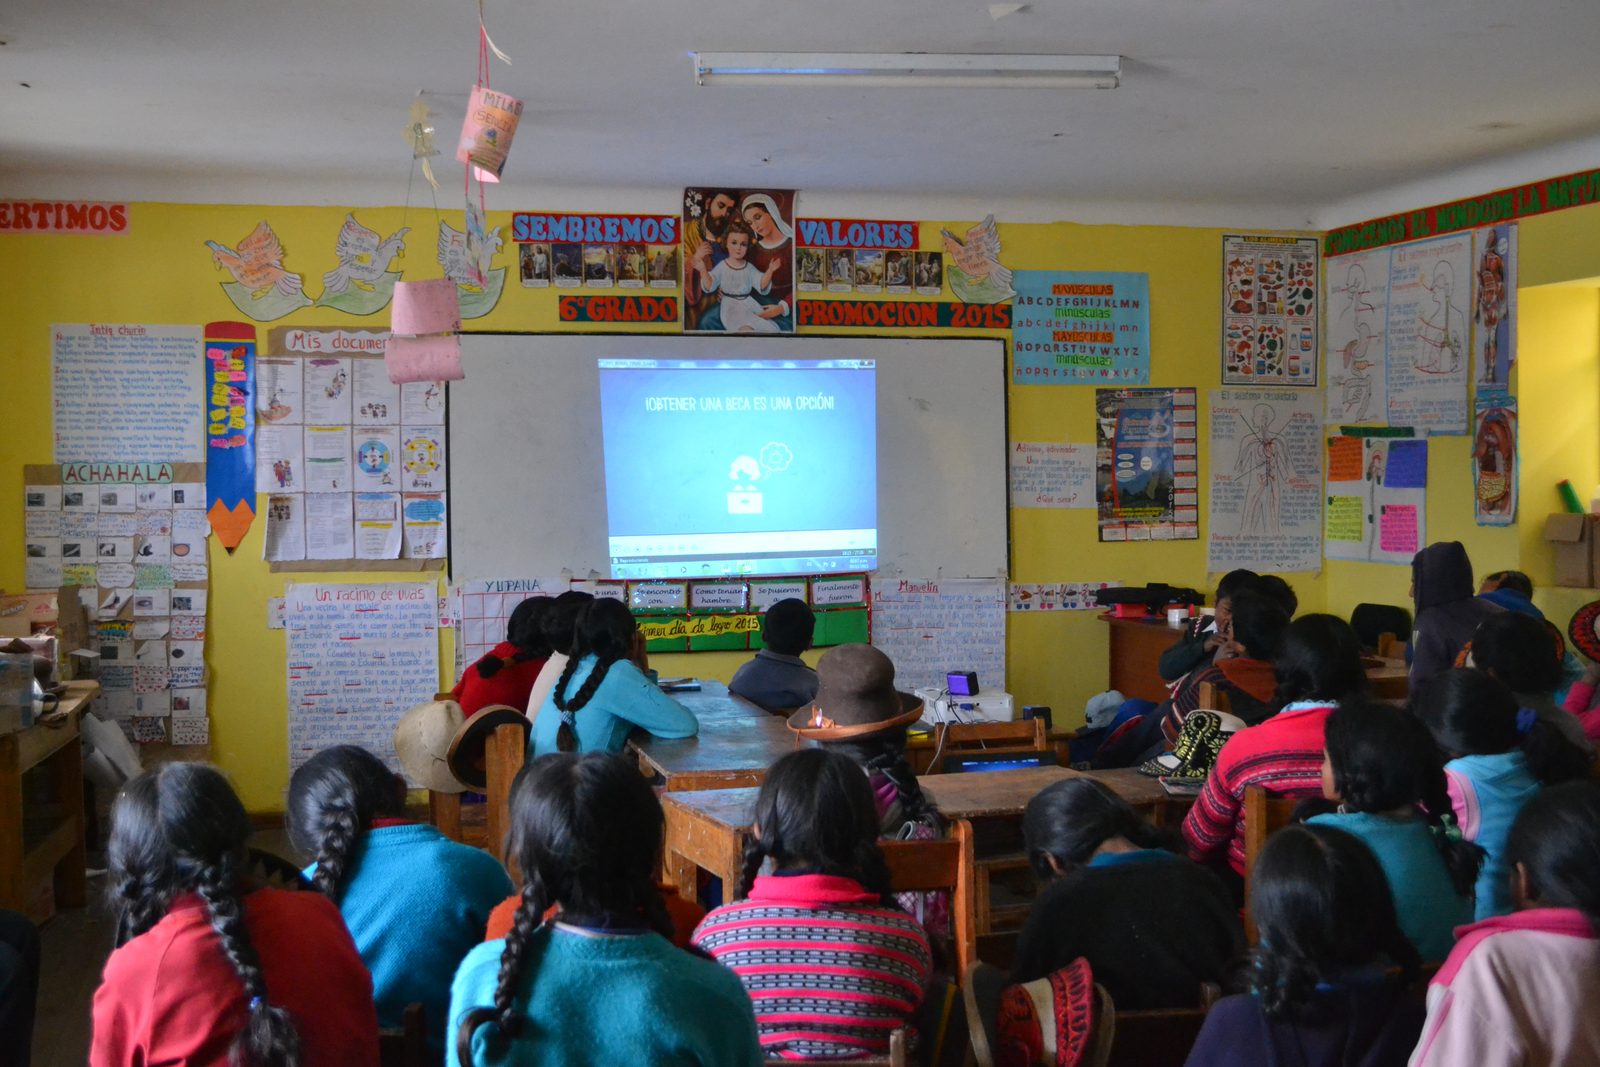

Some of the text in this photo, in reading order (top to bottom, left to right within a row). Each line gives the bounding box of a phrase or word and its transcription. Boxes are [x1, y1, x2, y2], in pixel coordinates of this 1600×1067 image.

[1412, 210, 1430, 237] EL
[1518, 186, 1541, 215] LA
[513, 215, 914, 249] SEMBREMOS VALORES
[800, 301, 938, 326] PROMOCION
[950, 304, 1011, 329] 2015
[291, 331, 321, 349] Mis
[700, 396, 723, 411] UNA
[725, 396, 751, 411] BECA
[753, 396, 767, 411] ES
[770, 396, 793, 411] UNA
[795, 391, 835, 411] OPCIÓN!
[65, 464, 171, 482] ACHAHALA
[336, 587, 376, 601] racimo
[485, 579, 541, 593] YUPANA
[690, 618, 705, 633] de
[734, 617, 759, 630] 2015
